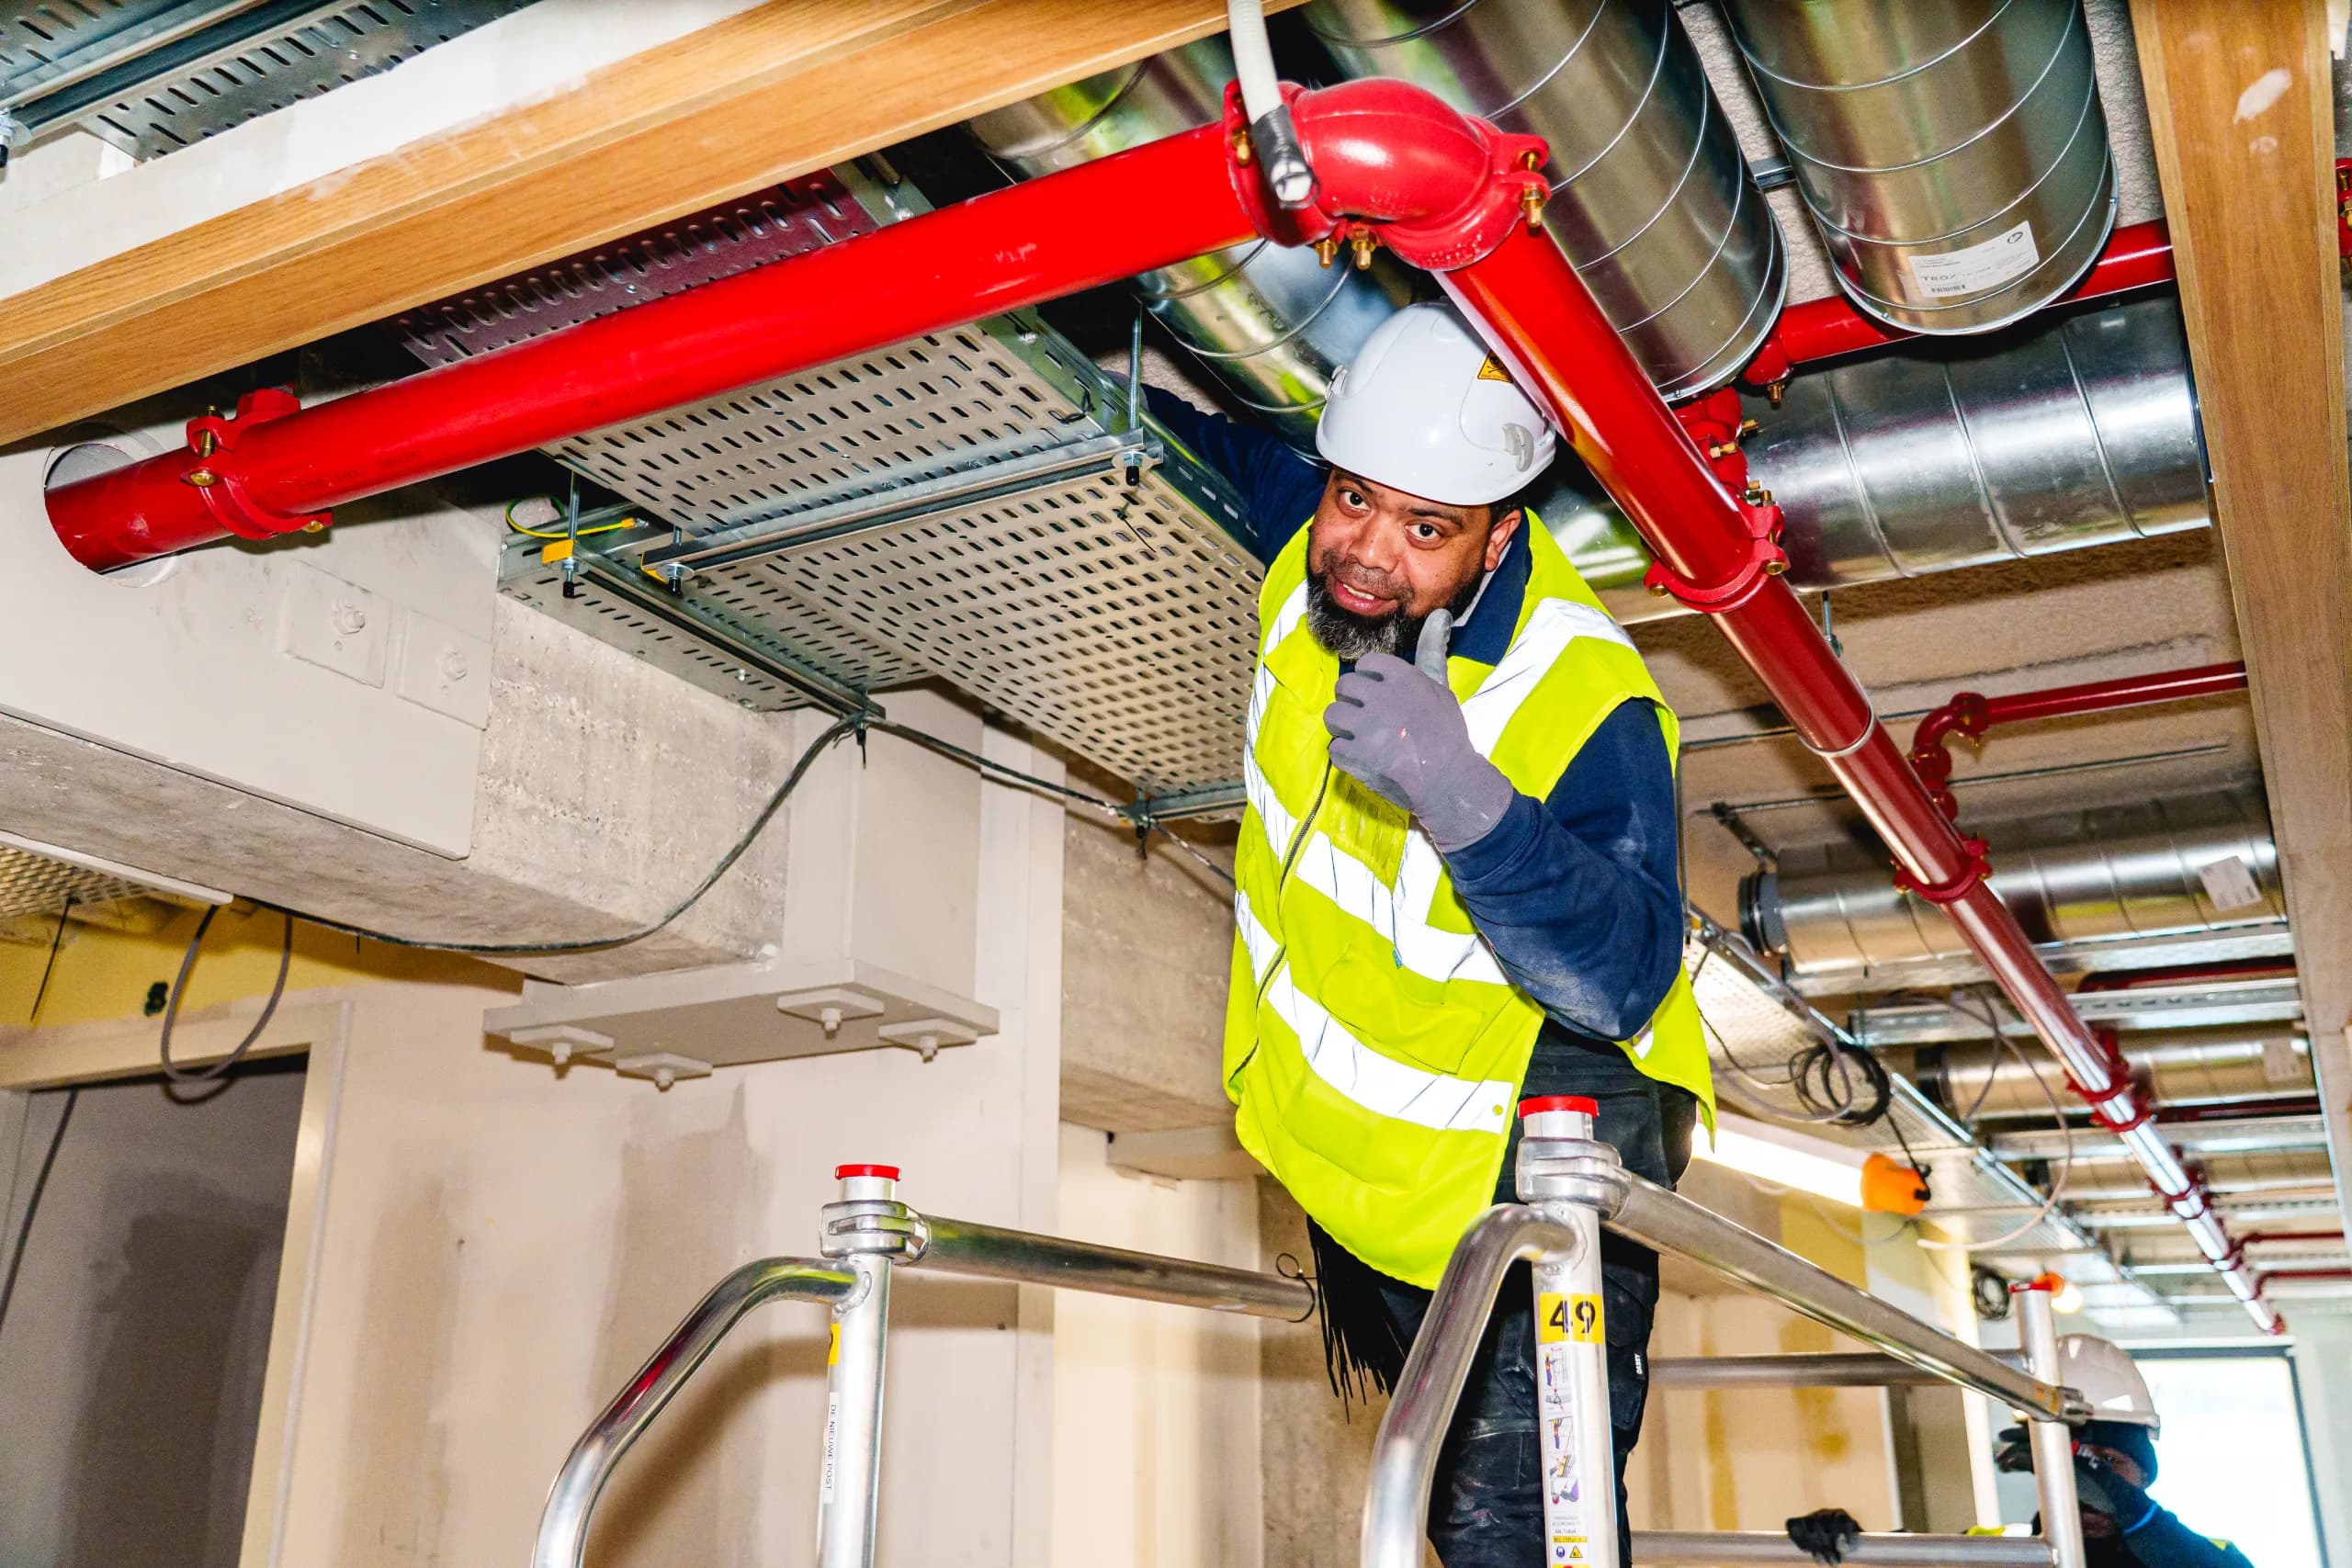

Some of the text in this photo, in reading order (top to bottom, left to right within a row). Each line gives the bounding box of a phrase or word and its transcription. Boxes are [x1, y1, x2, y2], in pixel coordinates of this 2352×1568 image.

[1549, 1300, 1596, 1334] 49
[825, 1404, 837, 1491] DE NIEUWE POST
